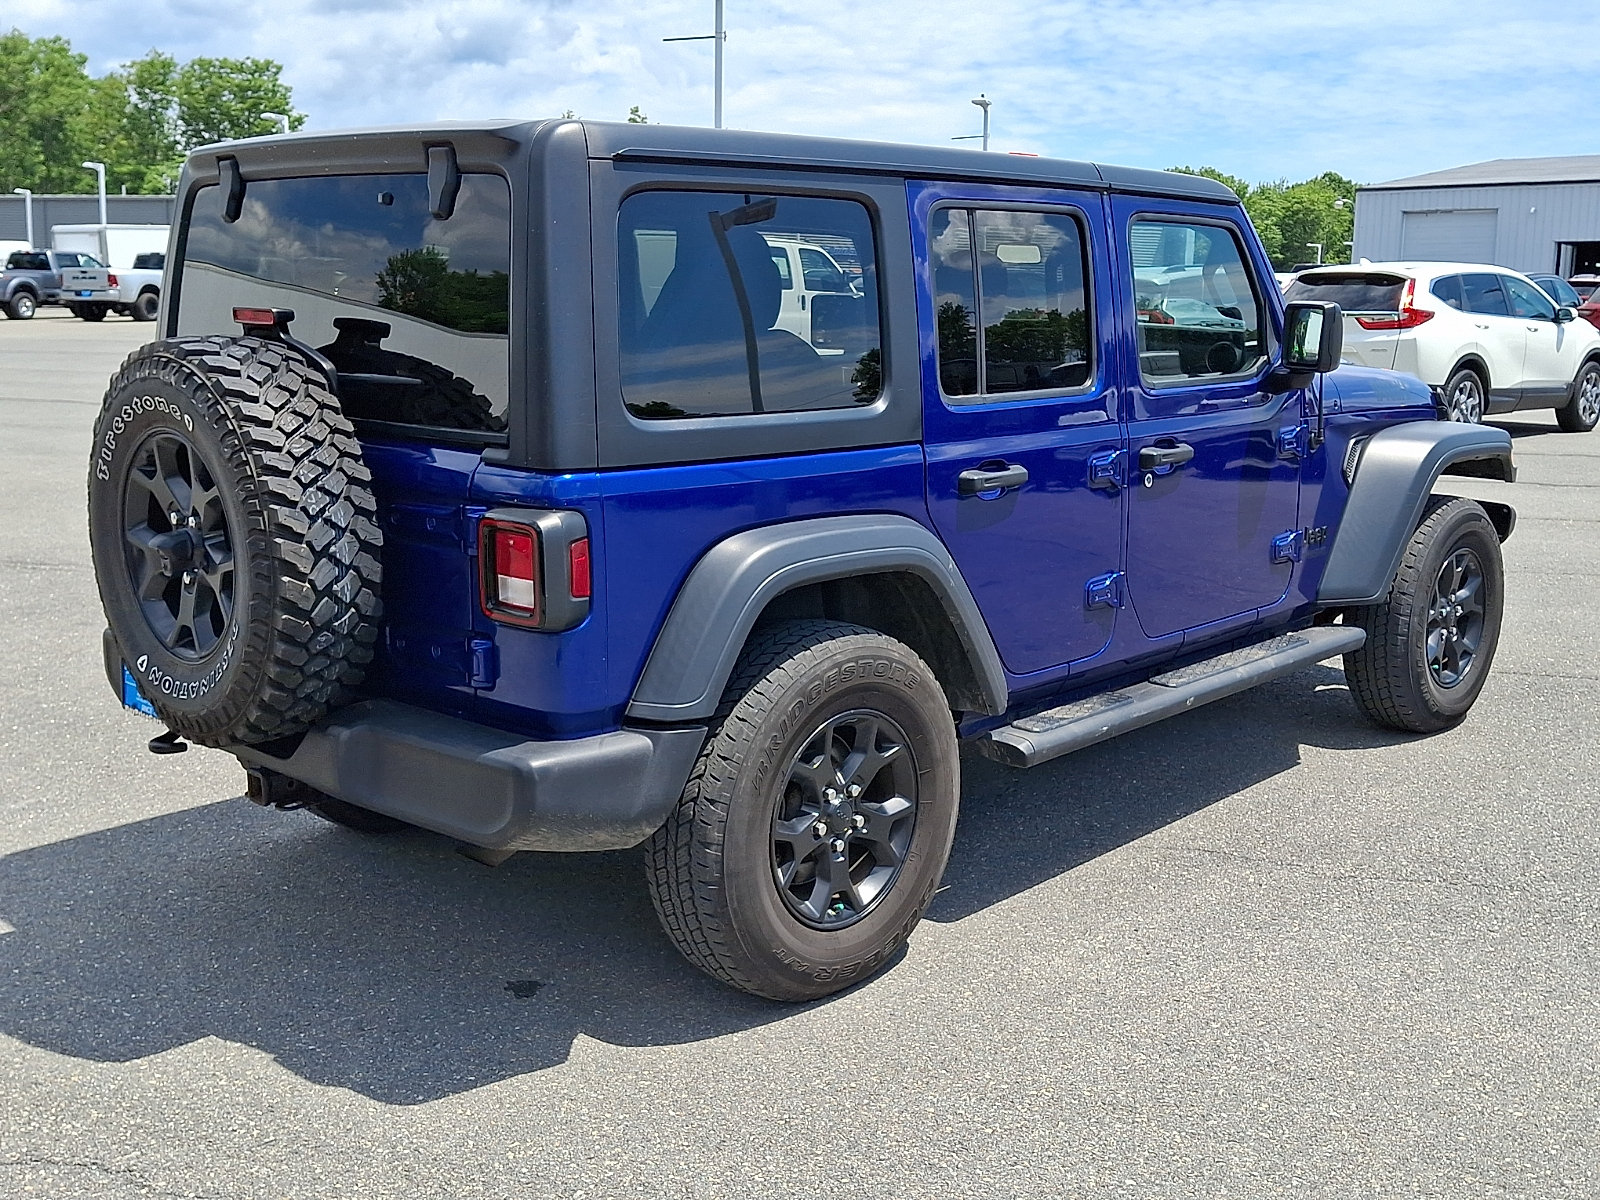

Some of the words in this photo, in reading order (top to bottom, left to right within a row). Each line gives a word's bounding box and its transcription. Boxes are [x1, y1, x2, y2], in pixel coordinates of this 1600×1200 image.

[96, 394, 183, 482] Firestone
[1303, 525, 1328, 546] Jeep
[751, 658, 923, 797] BRIDGESTONE
